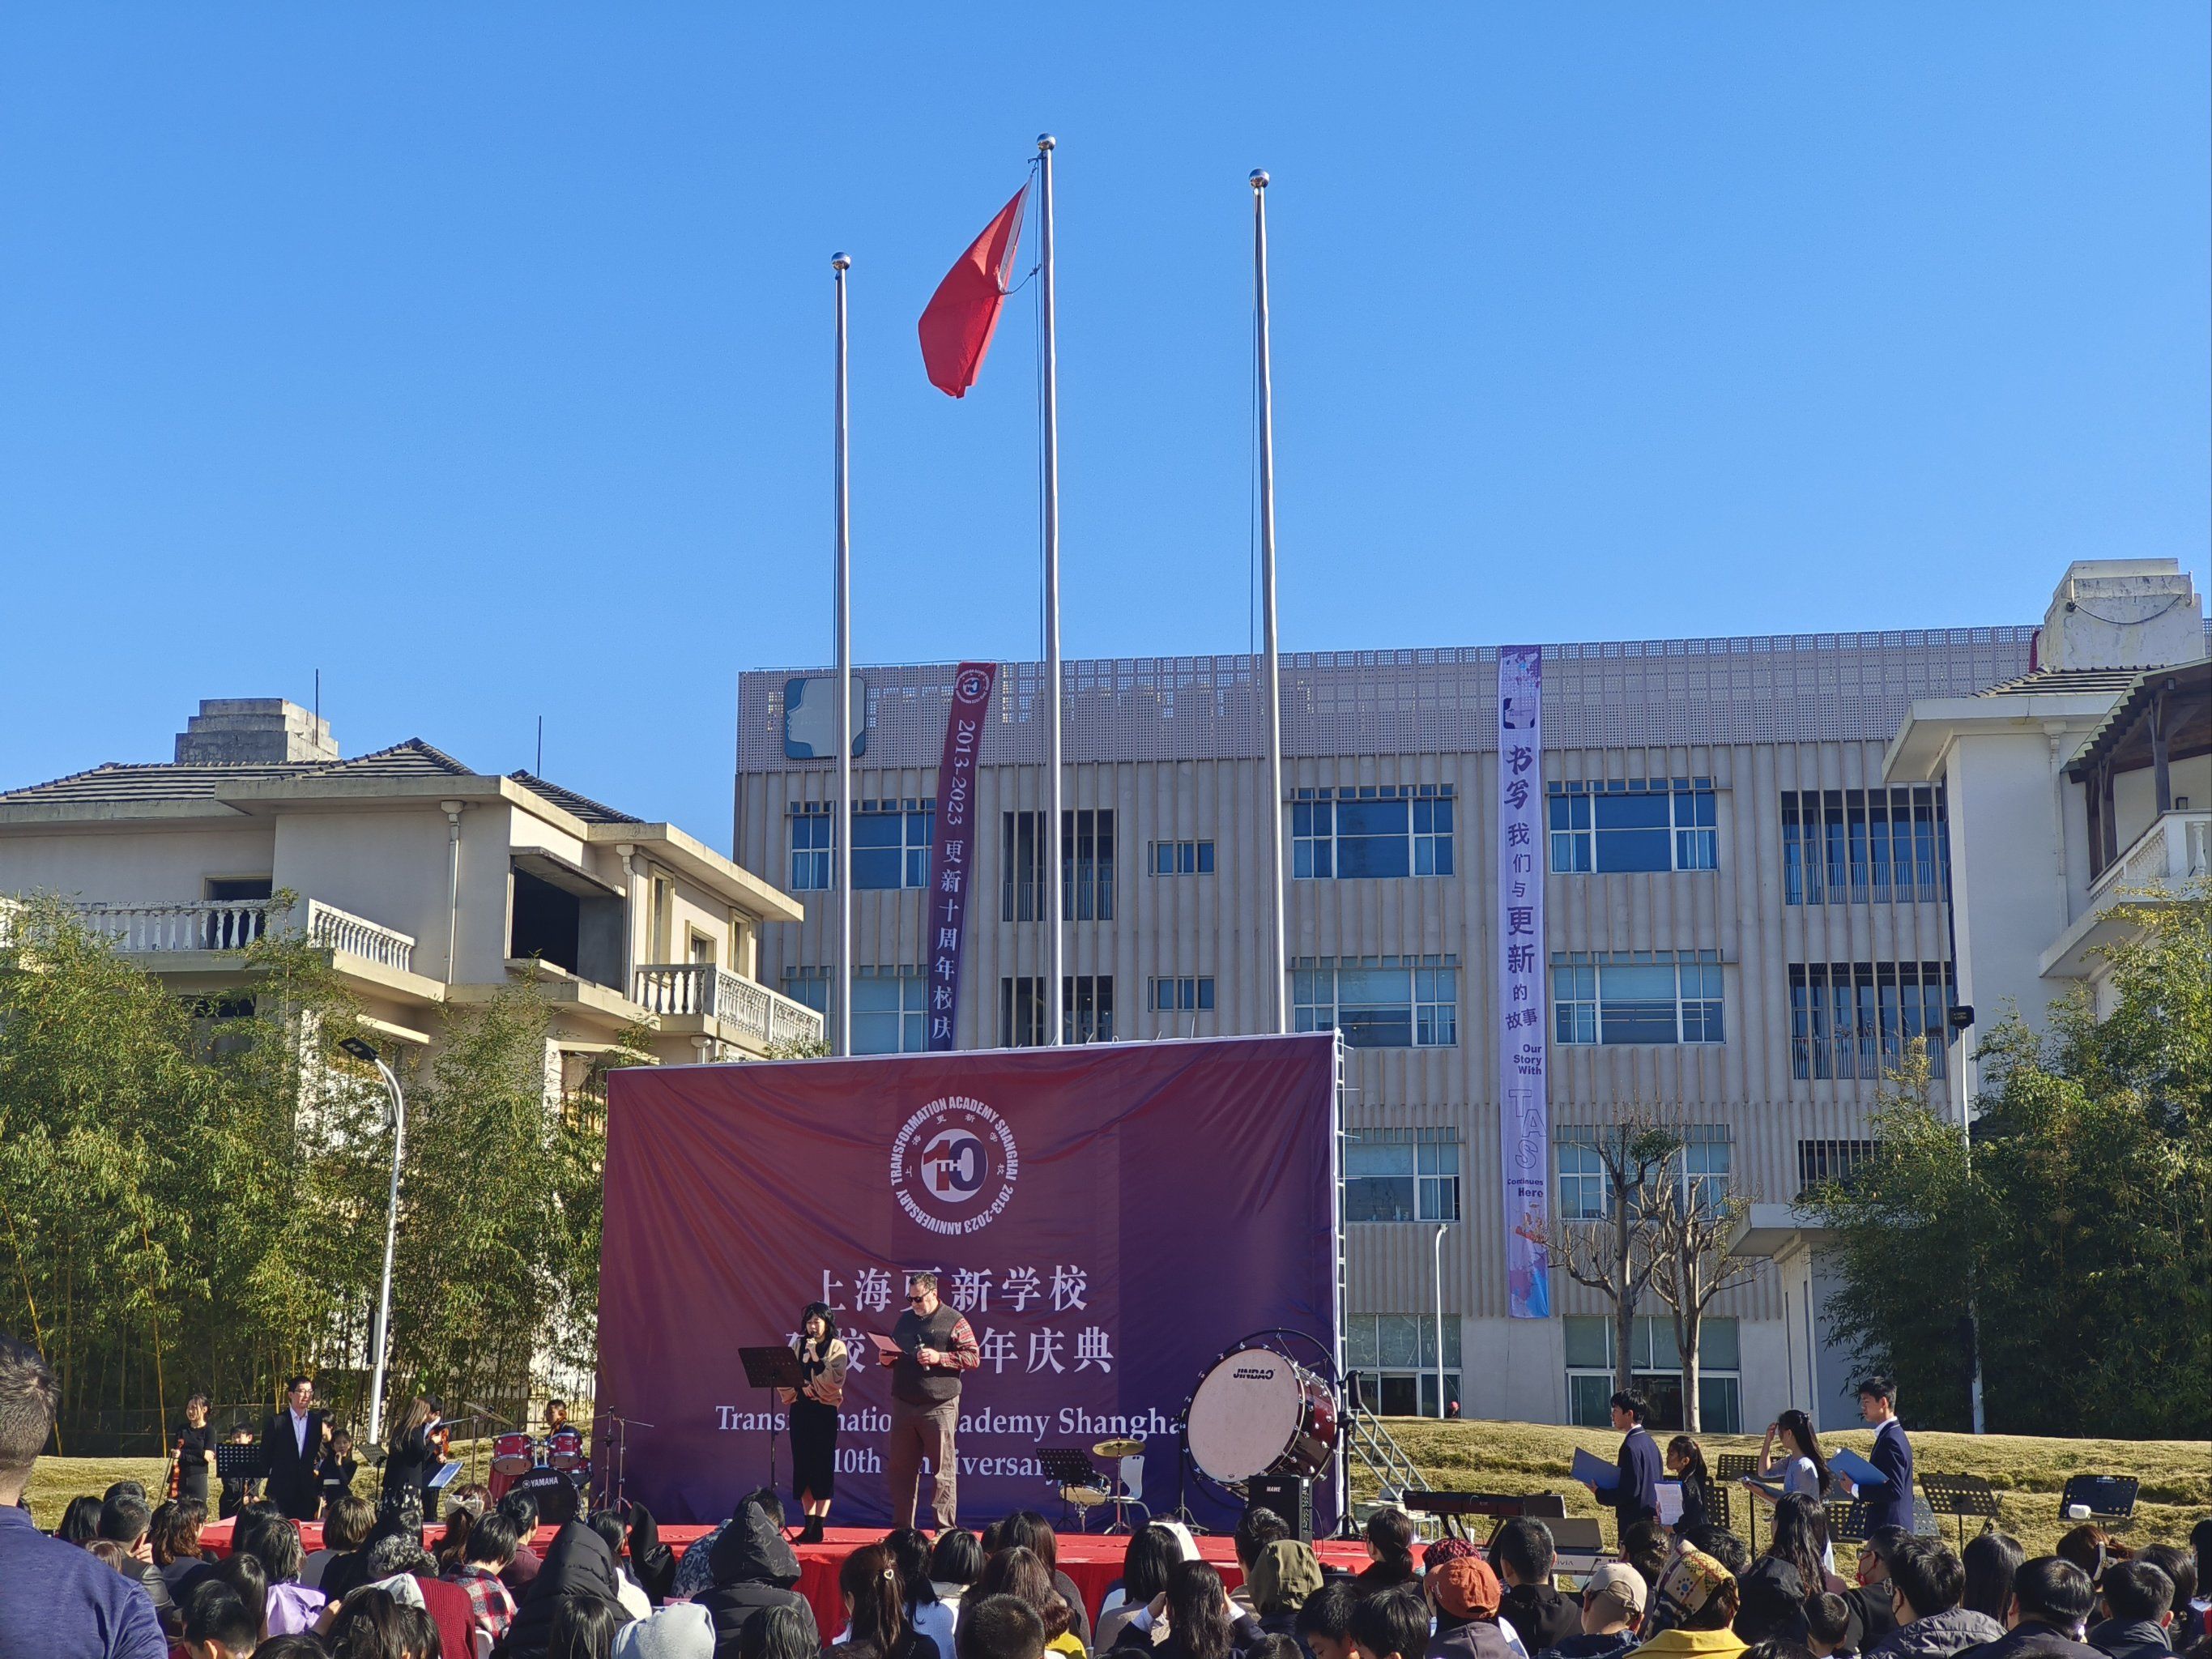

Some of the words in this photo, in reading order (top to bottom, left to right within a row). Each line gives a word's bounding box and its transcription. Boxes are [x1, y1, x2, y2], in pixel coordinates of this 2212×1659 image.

[947, 719, 976, 825] 2013-2023
[1504, 744, 1538, 1031] 书写我们与更新的故事
[932, 839, 964, 1039] 更新十周年校庆
[1513, 1054, 1542, 1066] Story
[1523, 1043, 1542, 1053] Our
[1518, 1065, 1542, 1075] With
[890, 1097, 948, 1186] TRANSFORMATION
[948, 1096, 999, 1124] ACADEMY
[994, 1119, 1019, 1181] SHANGHAI
[964, 1183, 1014, 1234] 2013-2023
[1518, 1187, 1544, 1198] Here
[895, 1188, 962, 1235] ANNIVERSARY
[955, 1406, 1051, 1443] ademy
[1059, 1406, 1180, 1443] Shangha
[833, 1447, 882, 1473] 10th
[531, 1476, 559, 1487] YAMAHA
